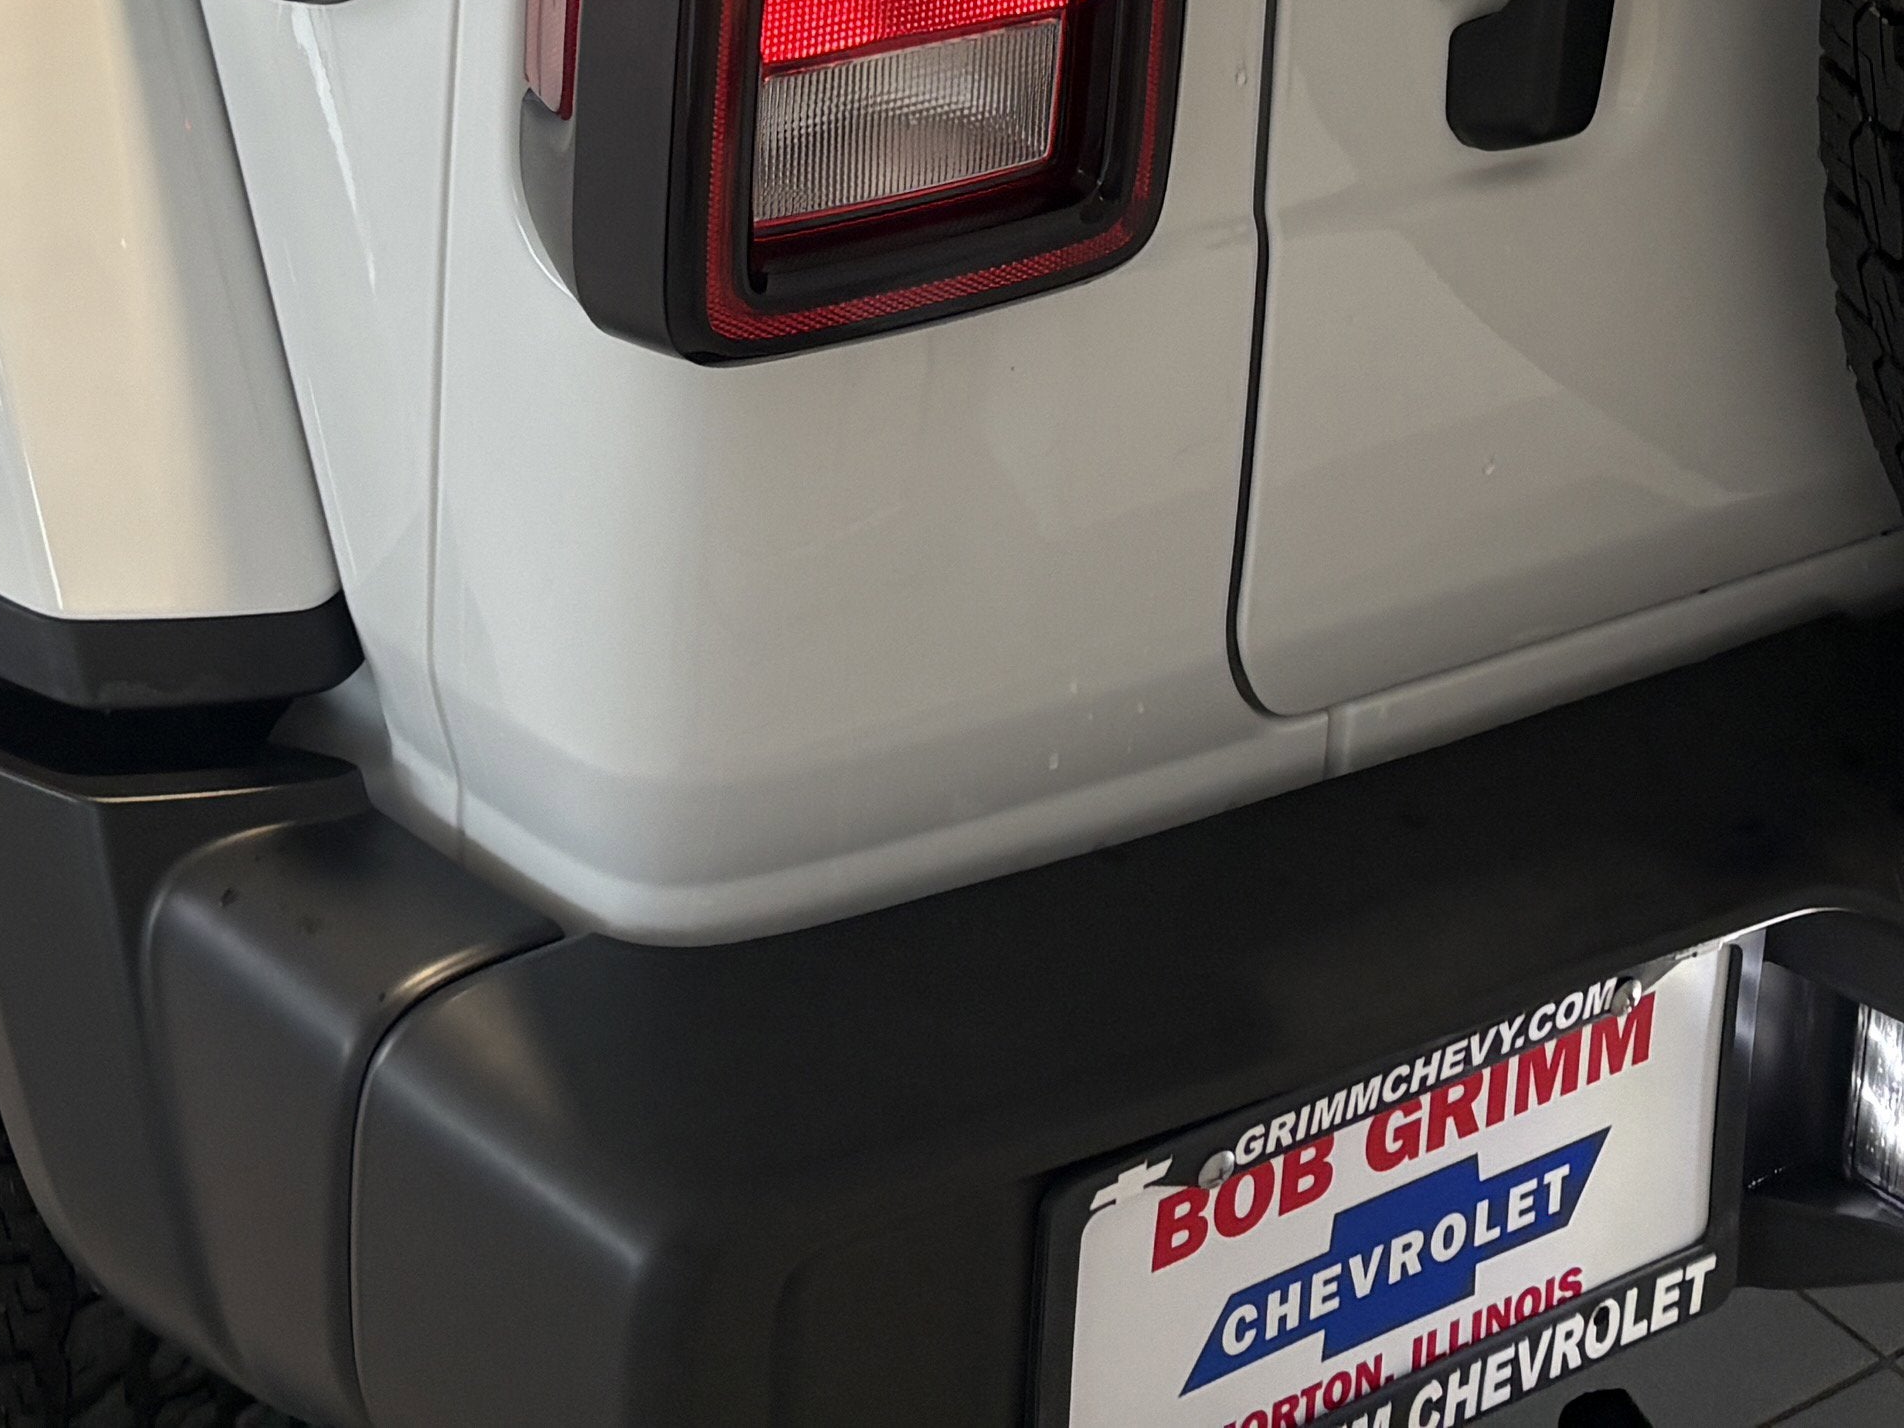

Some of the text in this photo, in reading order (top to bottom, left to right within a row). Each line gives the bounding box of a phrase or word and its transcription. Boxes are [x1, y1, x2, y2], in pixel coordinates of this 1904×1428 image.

[1150, 990, 1657, 1272] BOB GRIMM
[1234, 977, 1620, 1166] GRIMMCHEVY.COM
[1220, 1161, 1575, 1356] CHEVROLET
[1405, 1255, 1716, 1428] CHEVROLET
[1409, 1266, 1583, 1369] ILLINOIS
